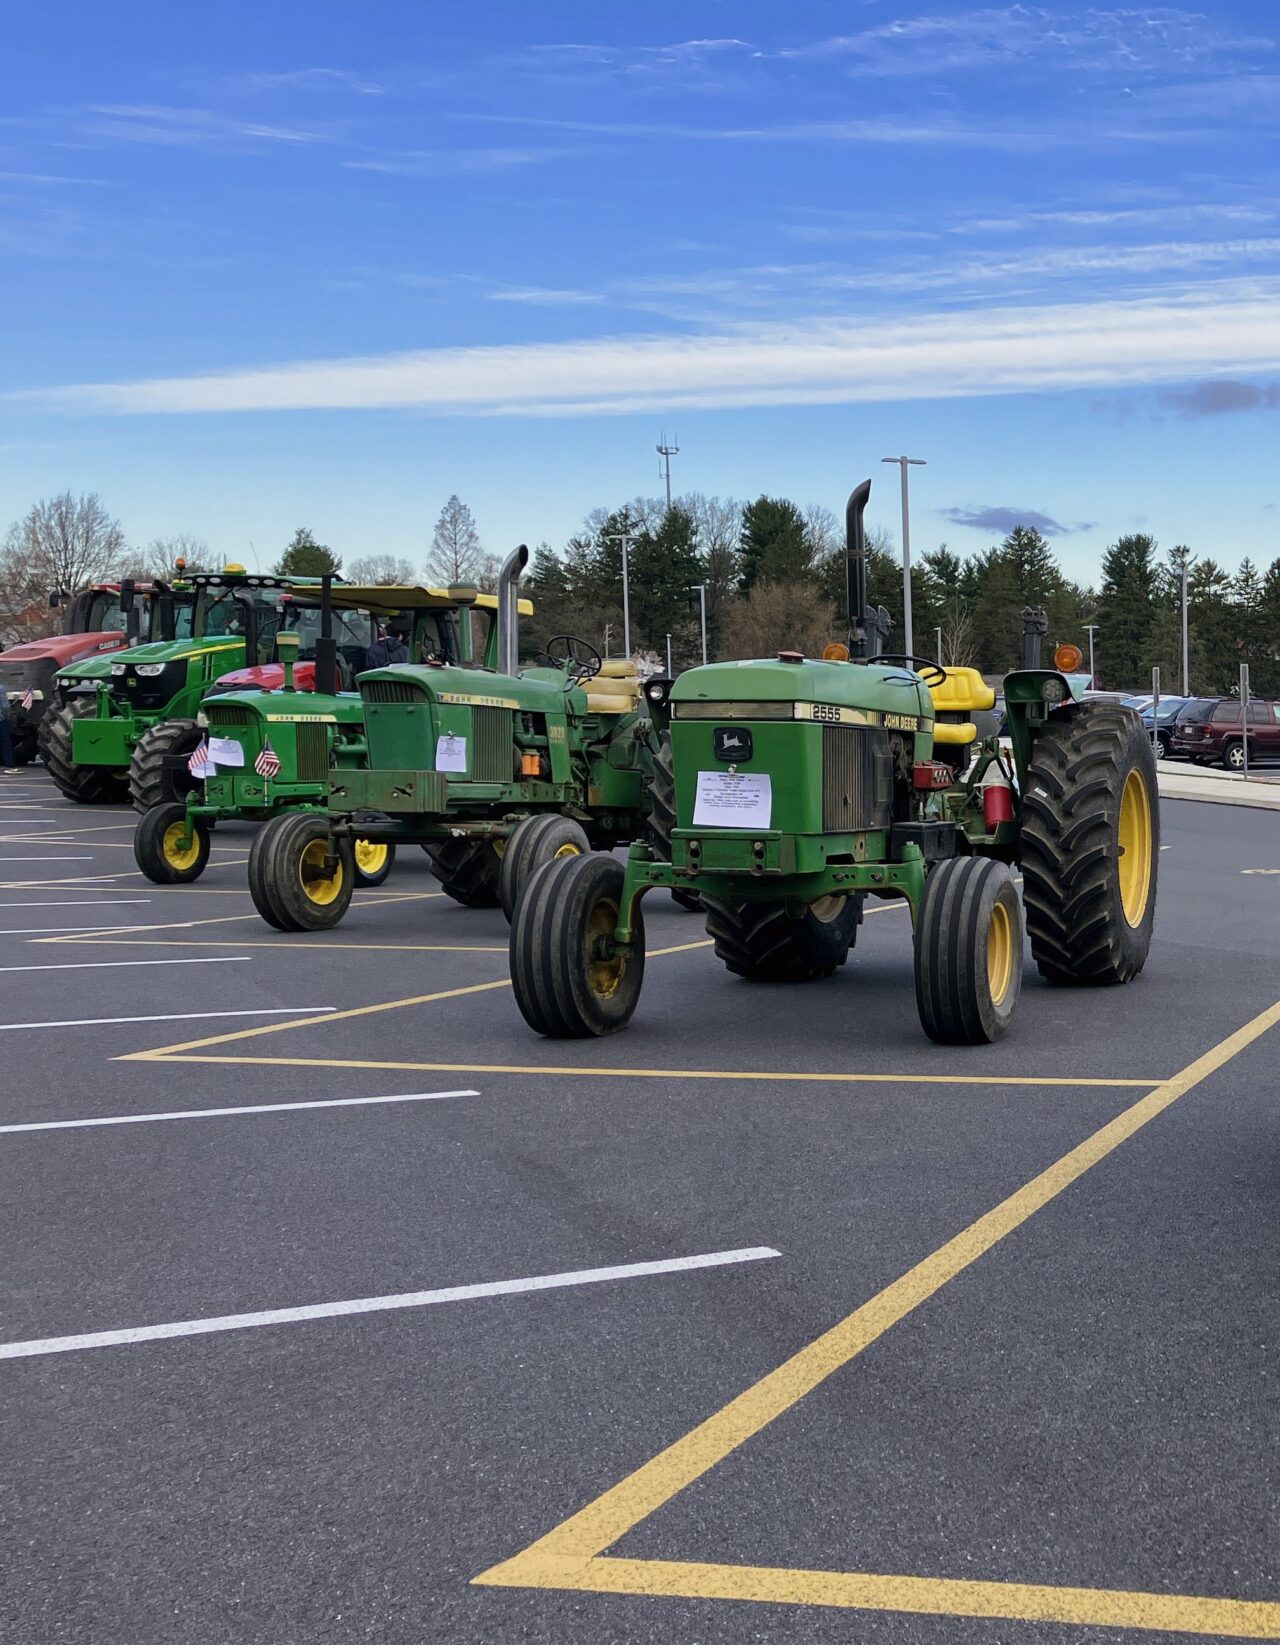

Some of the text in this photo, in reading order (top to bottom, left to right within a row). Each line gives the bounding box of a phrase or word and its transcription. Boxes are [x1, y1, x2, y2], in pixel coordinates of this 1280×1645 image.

[812, 704, 918, 731] 2555 JOHN DEERE
